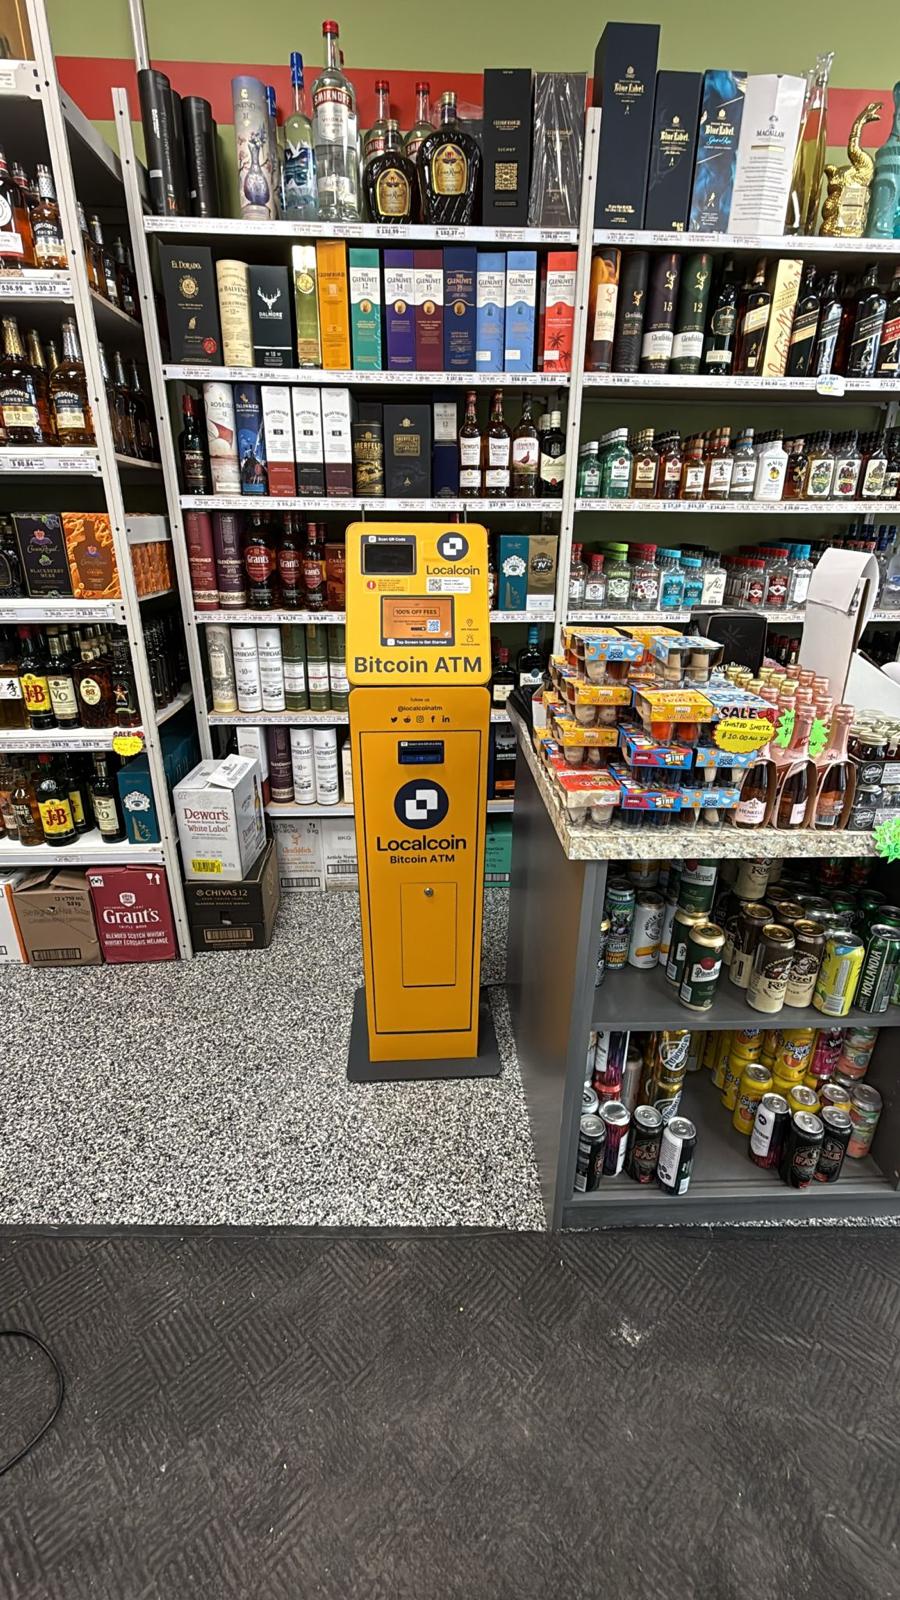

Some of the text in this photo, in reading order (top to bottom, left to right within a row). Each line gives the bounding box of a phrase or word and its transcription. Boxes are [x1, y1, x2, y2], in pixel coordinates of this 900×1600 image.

[613, 82, 645, 94] Blue Label
[314, 91, 351, 106] SMIRNOFF
[704, 125, 734, 136] Blue Label
[660, 131, 689, 142] Blue Label
[663, 301, 673, 312] 15
[693, 302, 703, 313] 12
[0, 388, 30, 399] GIBSON'S
[247, 555, 269, 564] Grant's
[279, 560, 299, 568] Grant's
[426, 565, 480, 575] Localcoin
[354, 656, 482, 673] Bitcoin ATM
[52, 688, 68, 702] VO
[720, 706, 758, 718] SALE
[723, 720, 747, 729] TWISTED
[46, 807, 67, 826] J&B
[183, 807, 231, 821] Dewar's
[376, 835, 467, 851] Localcoin
[390, 855, 455, 864] Bitcoin ATM
[205, 889, 248, 897] CHIVAS 12
[103, 908, 160, 924] Grant's
[147, 930, 165, 938] WHISKY
[789, 974, 812, 983] ozel
[861, 950, 882, 996] HOLLANDIA
